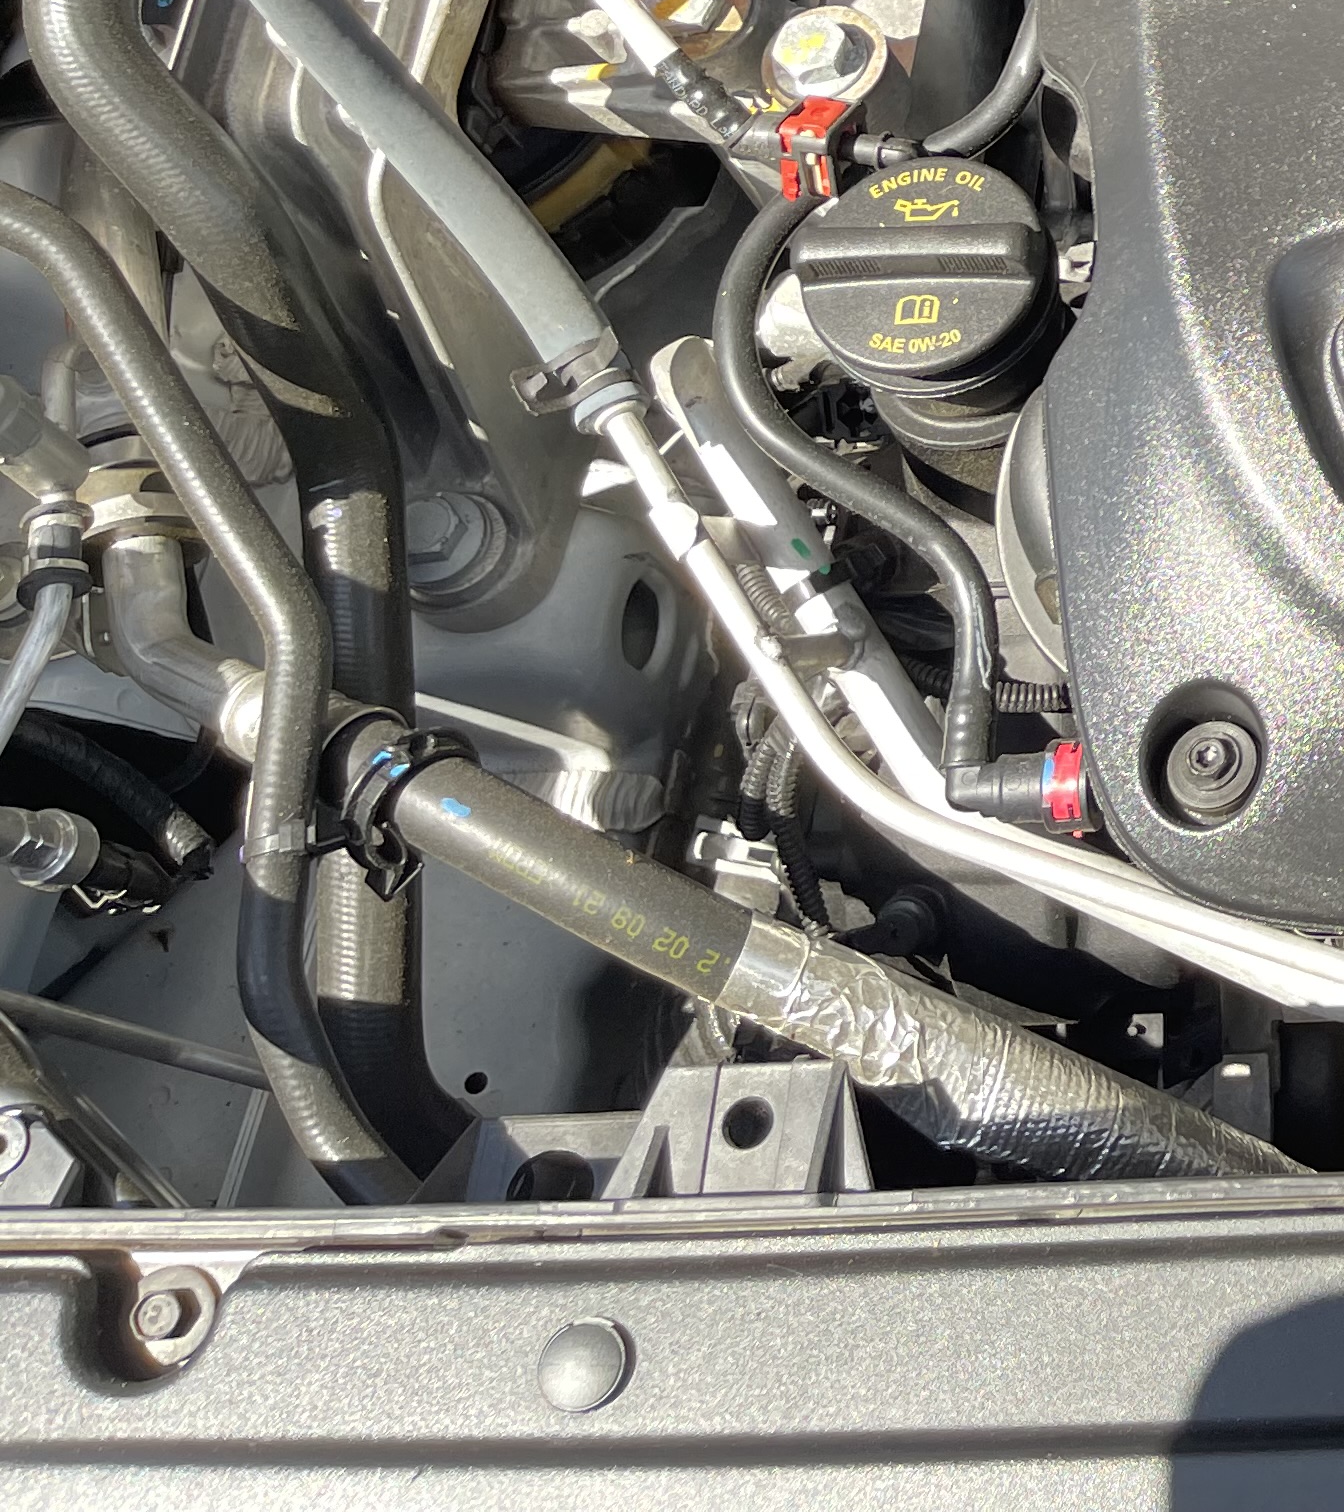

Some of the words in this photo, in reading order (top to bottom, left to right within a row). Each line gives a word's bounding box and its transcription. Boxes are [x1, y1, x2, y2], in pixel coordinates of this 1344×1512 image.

[868, 167, 949, 199] ENGINE
[954, 170, 986, 192] OIL
[868, 332, 907, 354] SAE
[907, 328, 962, 354] 0W-20
[571, 887, 607, 917] 21
[652, 925, 690, 960] 02
